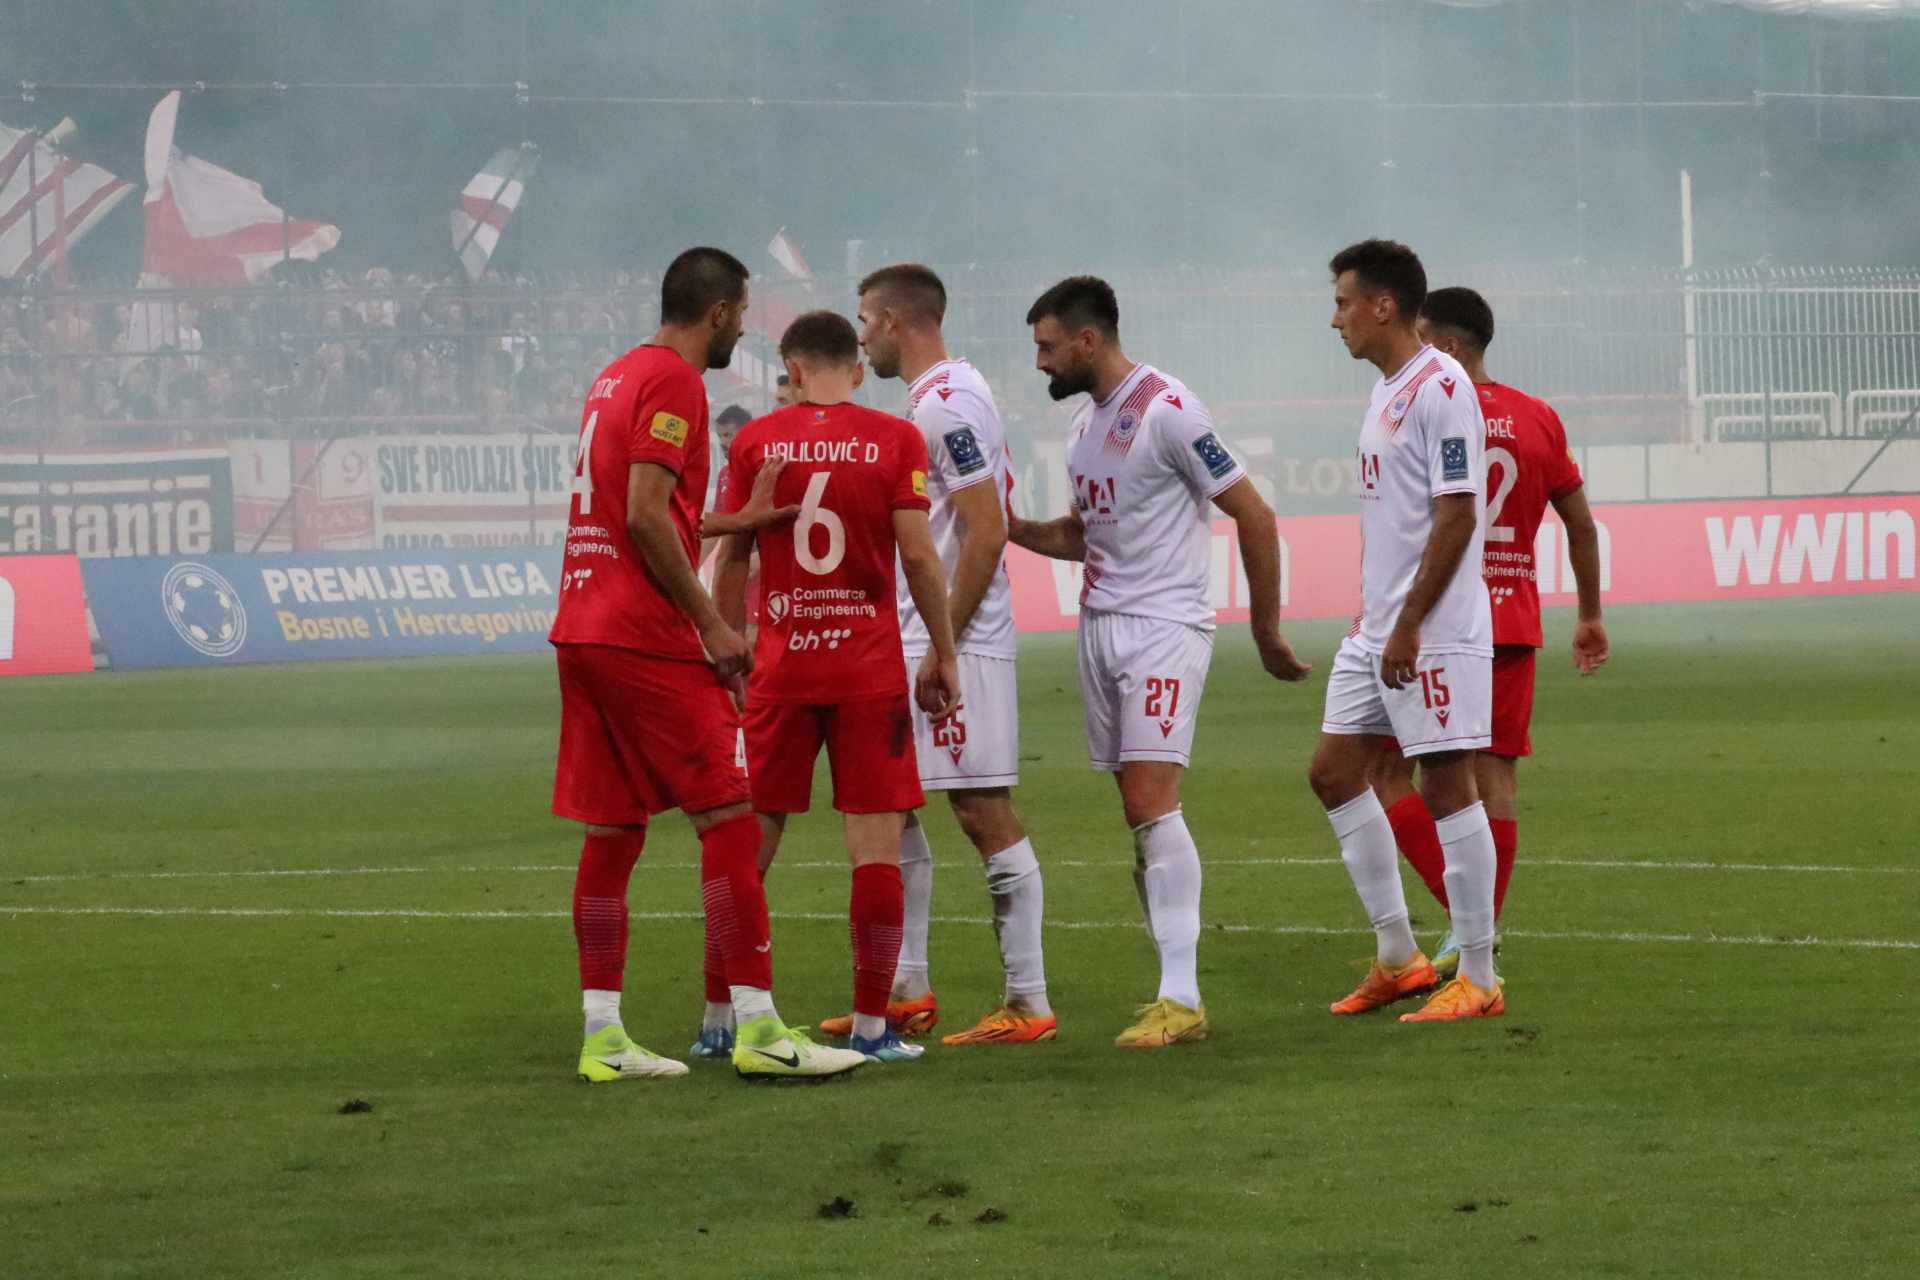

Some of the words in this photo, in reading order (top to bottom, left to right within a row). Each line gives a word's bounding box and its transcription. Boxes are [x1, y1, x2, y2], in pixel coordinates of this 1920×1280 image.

[378, 445, 422, 493] SVE
[425, 445, 517, 493] PROLAZI
[571, 410, 598, 515] 4
[764, 437, 858, 462] HALILOVIĆ
[865, 443, 878, 463] D
[1484, 447, 1518, 542] 2
[793, 471, 846, 575] 6
[1705, 509, 1916, 587] wwin
[262, 564, 457, 604] PREMIJER
[459, 561, 553, 599] LIGA
[793, 587, 866, 600] Commerce
[277, 611, 371, 641] Bosne
[376, 608, 390, 637] i
[793, 604, 876, 619] Engineering
[1145, 678, 1181, 717] 27
[1419, 667, 1450, 709] 15
[735, 727, 749, 778] 4
